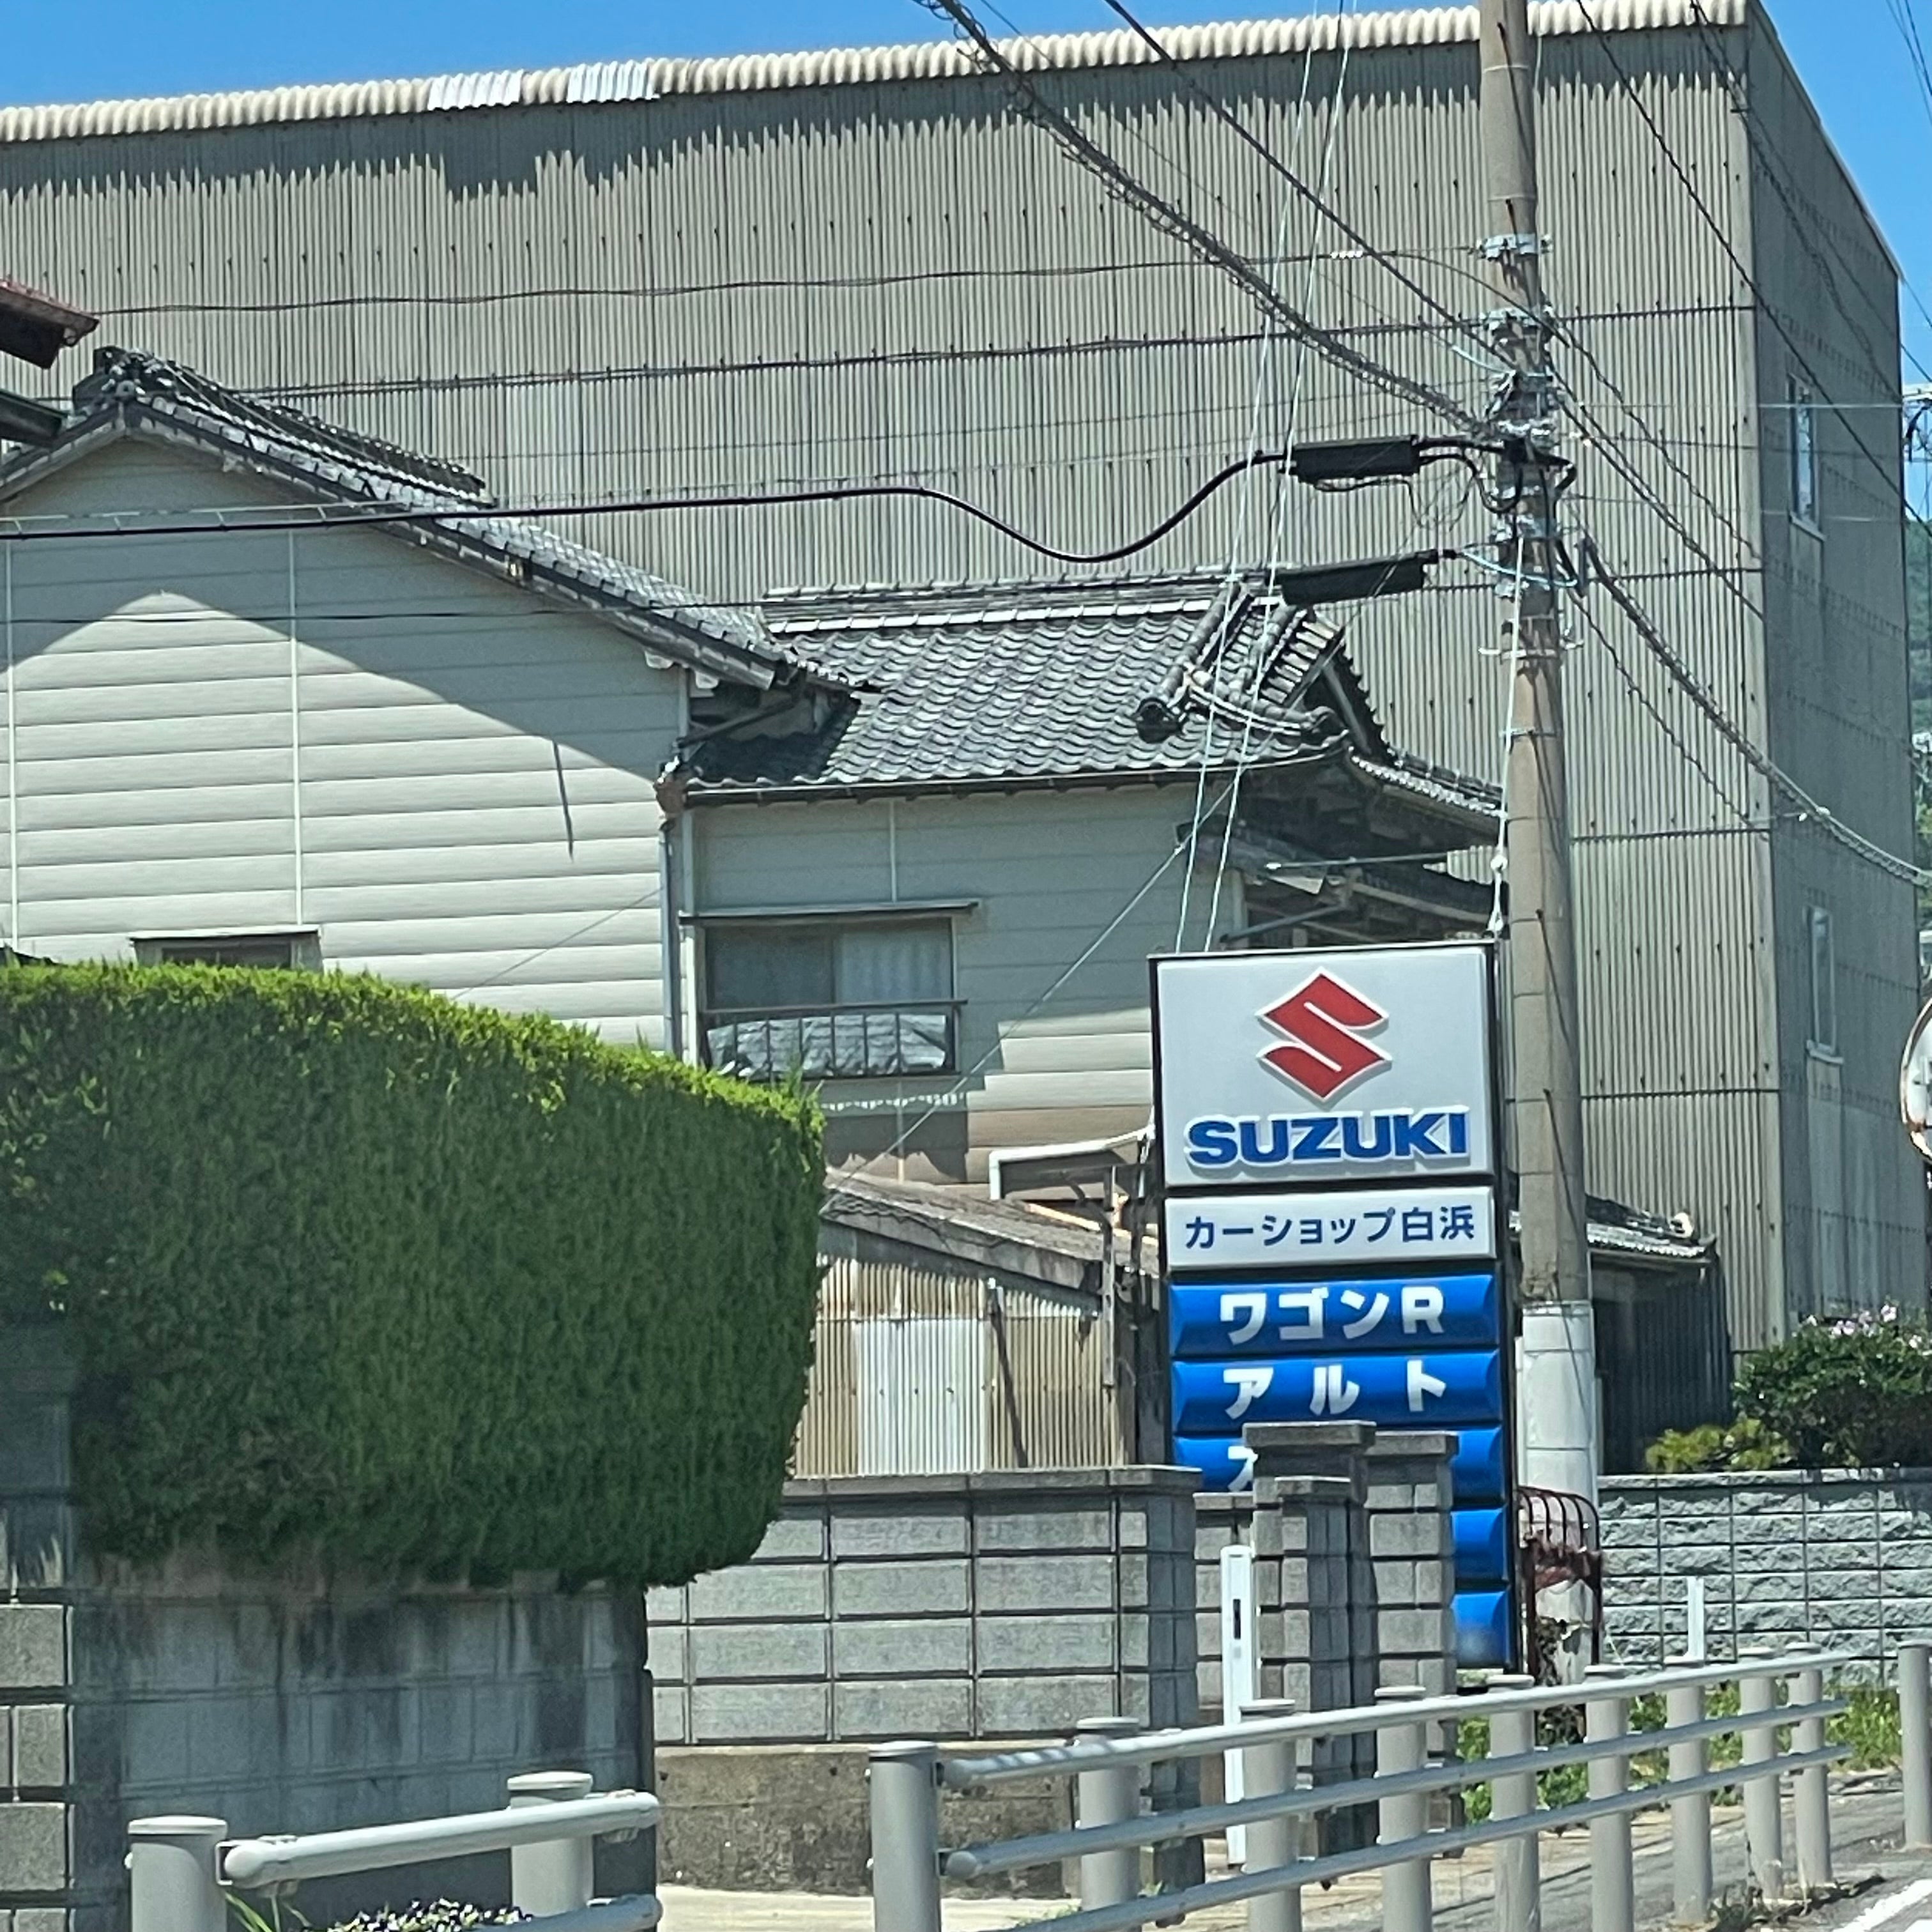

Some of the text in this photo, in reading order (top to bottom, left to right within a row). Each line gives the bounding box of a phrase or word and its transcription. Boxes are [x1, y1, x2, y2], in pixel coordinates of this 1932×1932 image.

[1188, 1112, 1466, 1165] SUZUKI
[1184, 1205, 1475, 1249] カーショップ白浜
[1220, 1285, 1445, 1346] ワゴンR
